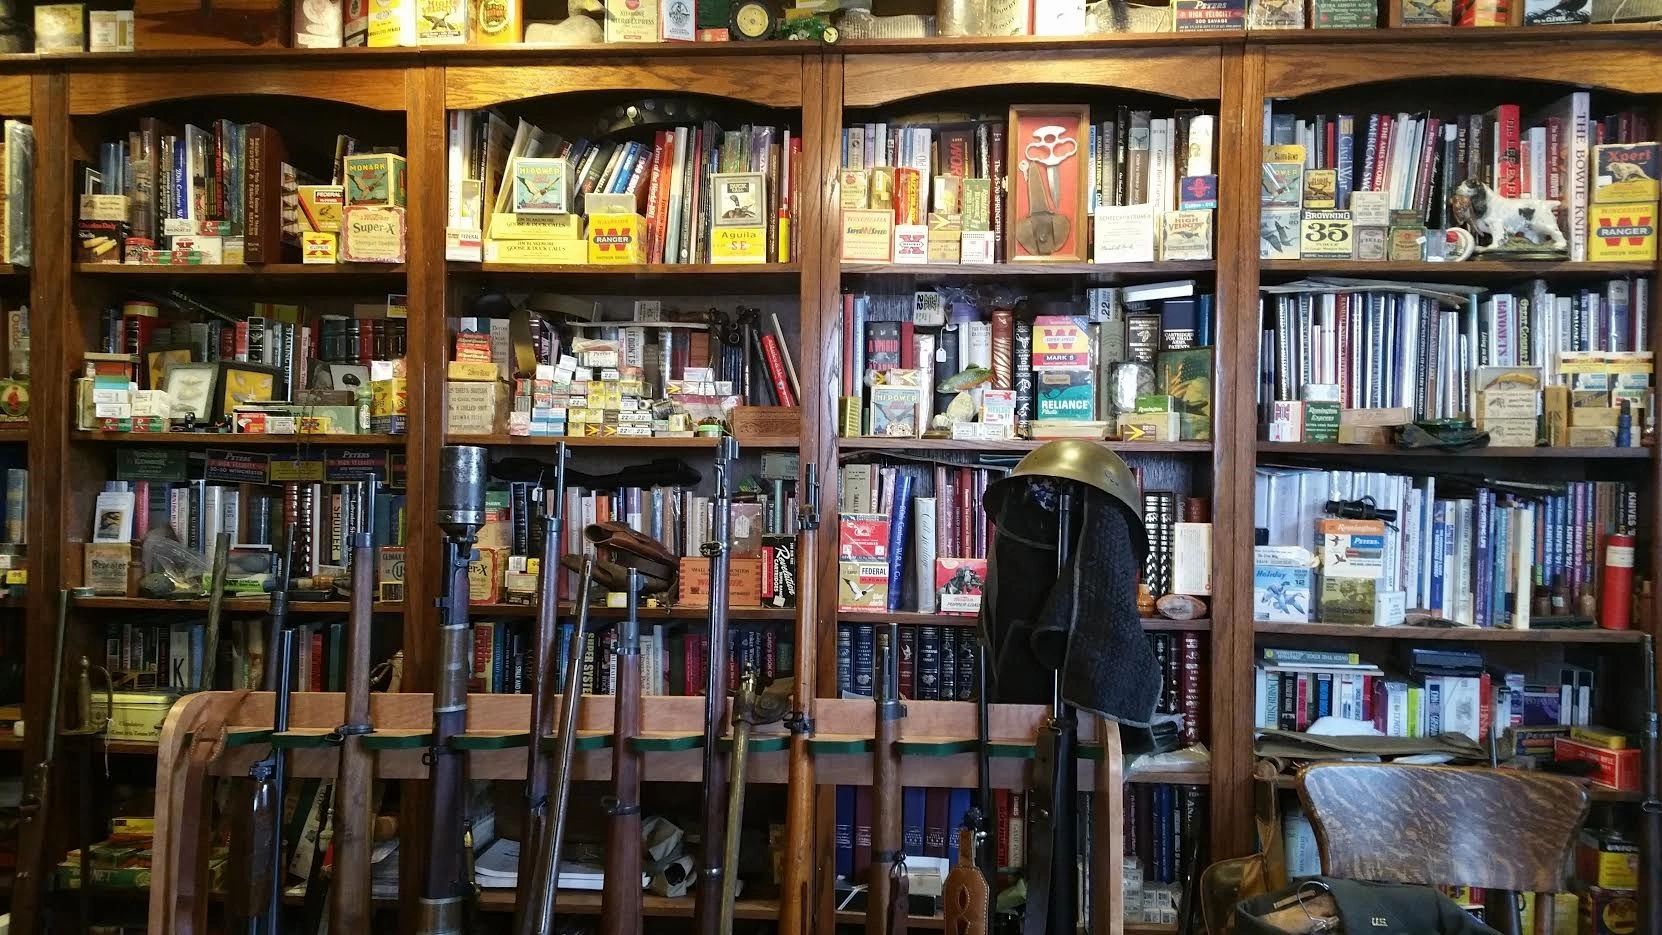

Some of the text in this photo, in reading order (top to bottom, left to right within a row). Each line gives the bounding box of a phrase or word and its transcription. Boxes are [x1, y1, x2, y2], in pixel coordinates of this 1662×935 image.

[1195, 1, 1228, 9] PETERS
[1365, 114, 1378, 166] AMERICAN
[655, 145, 663, 159] Arms
[1338, 135, 1353, 190] Civil War
[1379, 143, 1388, 161] AMES
[1607, 151, 1651, 161] Xpert
[350, 163, 385, 171] MONARK
[1375, 162, 1385, 185] SWORD
[1575, 113, 1587, 251] THE BOWIE KNIFE
[353, 222, 396, 235] Super-X
[721, 231, 757, 239] Aguila
[1305, 222, 1350, 242] 35
[1601, 228, 1648, 236] RANGER
[1102, 301, 1110, 320] .22
[1498, 300, 1507, 359] BAYONETS
[1520, 299, 1529, 360] GREAT COMBAT
[1042, 400, 1088, 409] RELIANCE
[1628, 491, 1637, 527] KNIVES
[897, 520, 905, 546] Century
[920, 512, 932, 535] Colt
[1354, 537, 1379, 545] PETERS
[1545, 524, 1553, 553] KNIVES
[1555, 524, 1563, 553] KNIVES
[1565, 525, 1573, 554] KNIVES
[1575, 526, 1583, 554] KNIVES
[1585, 522, 1593, 550] KNIVES
[775, 544, 796, 596] Revelation
[893, 571, 901, 583] Co.
[1256, 570, 1287, 579] Holiday
[173, 657, 185, 687] K
[582, 664, 594, 695] SYSTE
[1268, 679, 1278, 723] DANIELLE STEEL
[1430, 690, 1440, 703] JOHN
